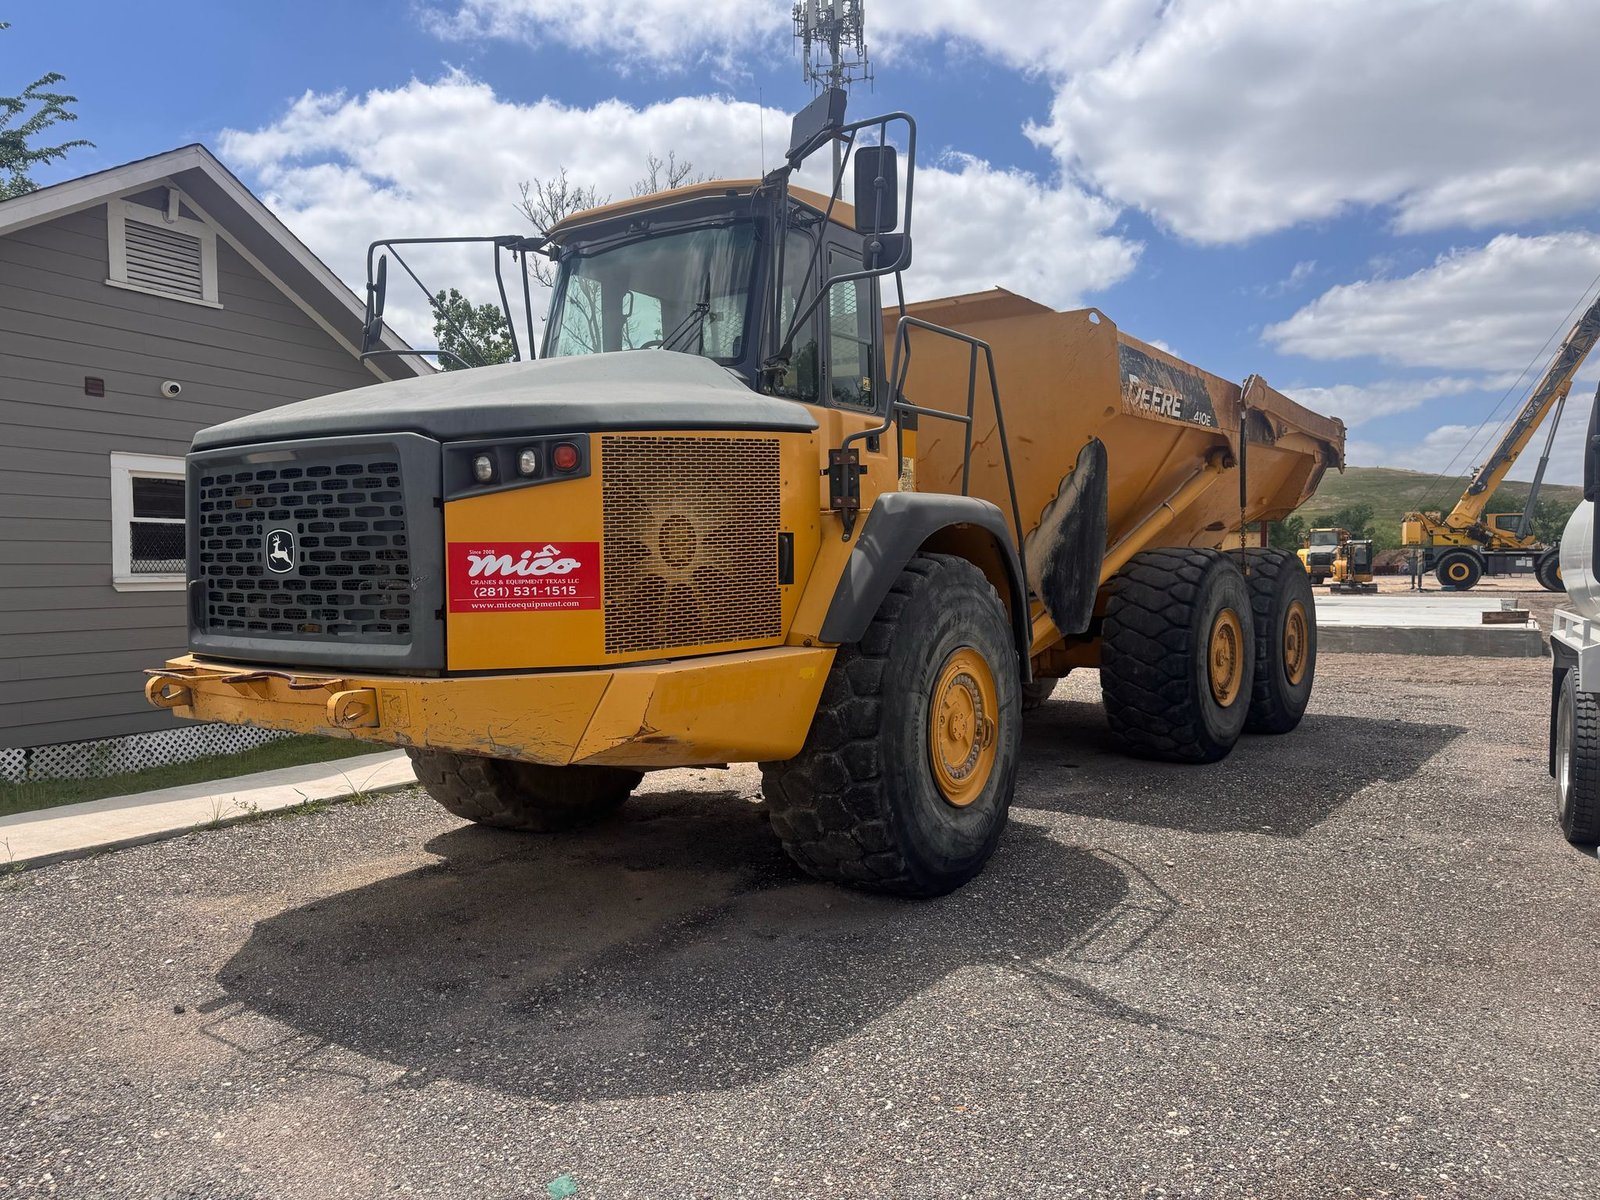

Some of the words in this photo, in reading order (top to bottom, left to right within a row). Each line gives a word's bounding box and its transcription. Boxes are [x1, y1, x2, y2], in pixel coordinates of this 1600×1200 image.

[1128, 373, 1183, 418] DEERE
[1193, 410, 1212, 427] 410E
[473, 587, 510, 598] (281)
[513, 585, 577, 596] 531-1515
[471, 600, 580, 611] www.micoequipment.com
